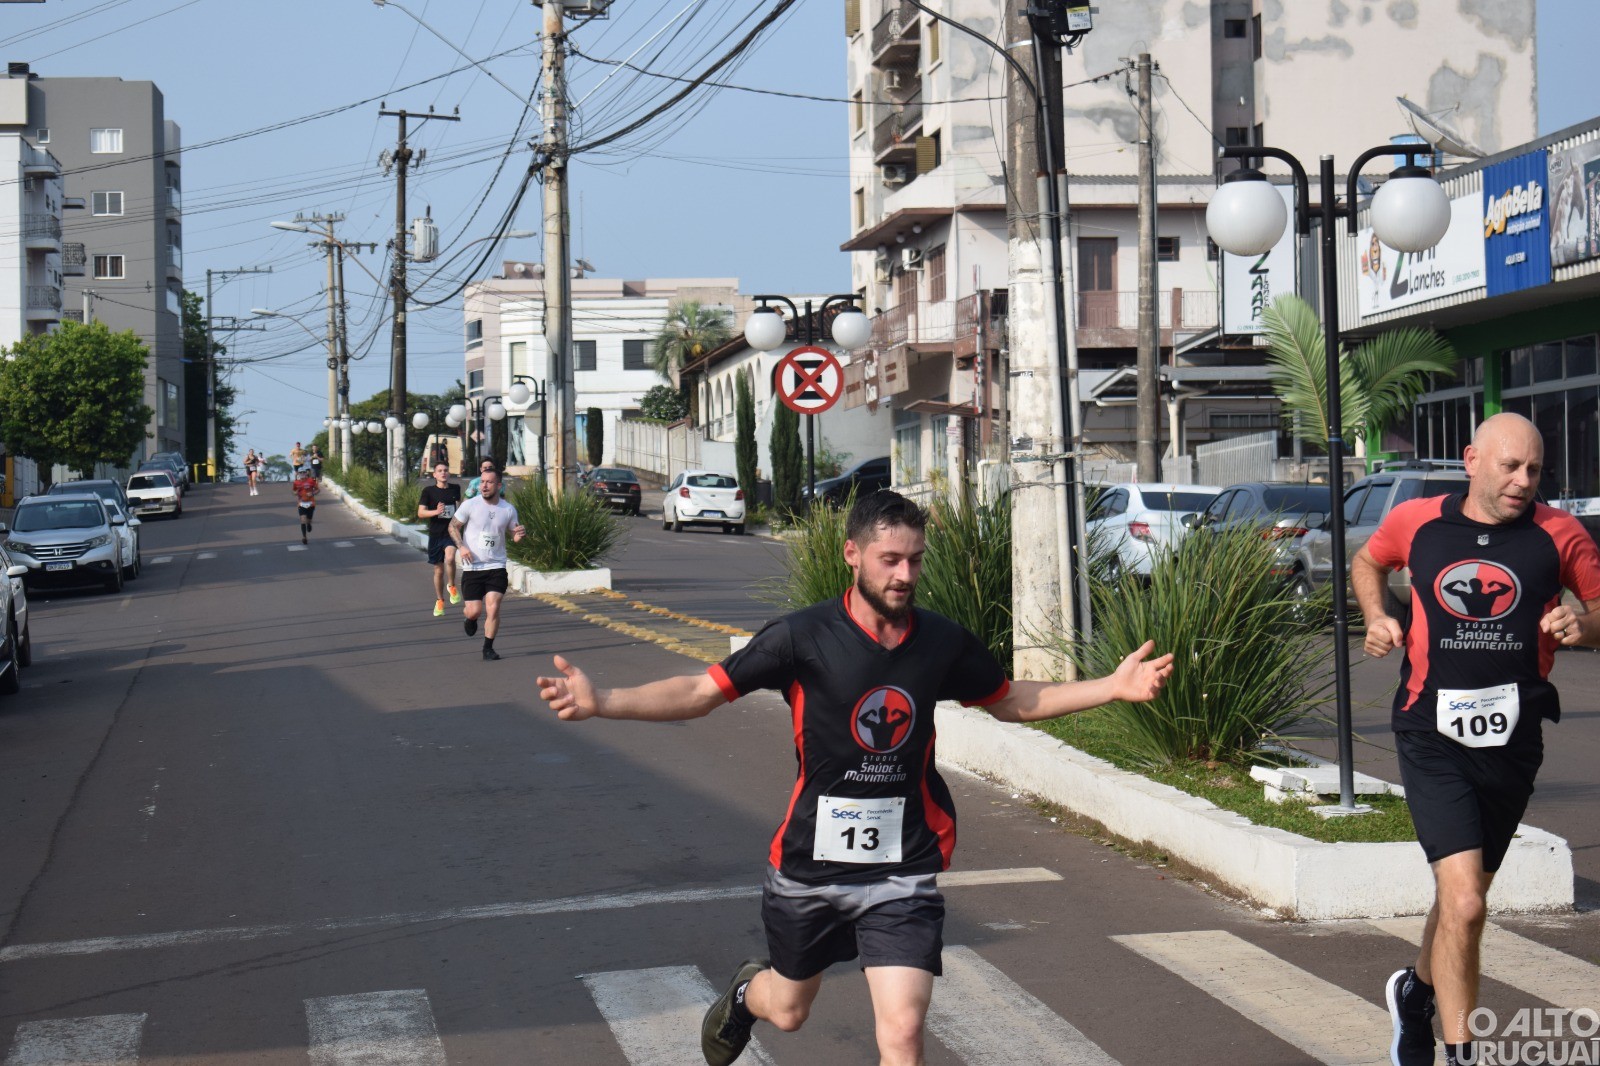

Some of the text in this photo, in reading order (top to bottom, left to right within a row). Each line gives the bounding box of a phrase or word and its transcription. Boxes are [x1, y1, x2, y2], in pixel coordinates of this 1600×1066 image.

[1484, 180, 1543, 233] AgroBella
[1409, 264, 1445, 295] Lanches
[485, 539, 495, 548] 79
[1456, 621, 1503, 630] STÚDIO
[1449, 700, 1477, 711] Sesc
[1450, 712, 1508, 738] 109
[831, 808, 863, 820] Sesc
[840, 826, 880, 851] 13
